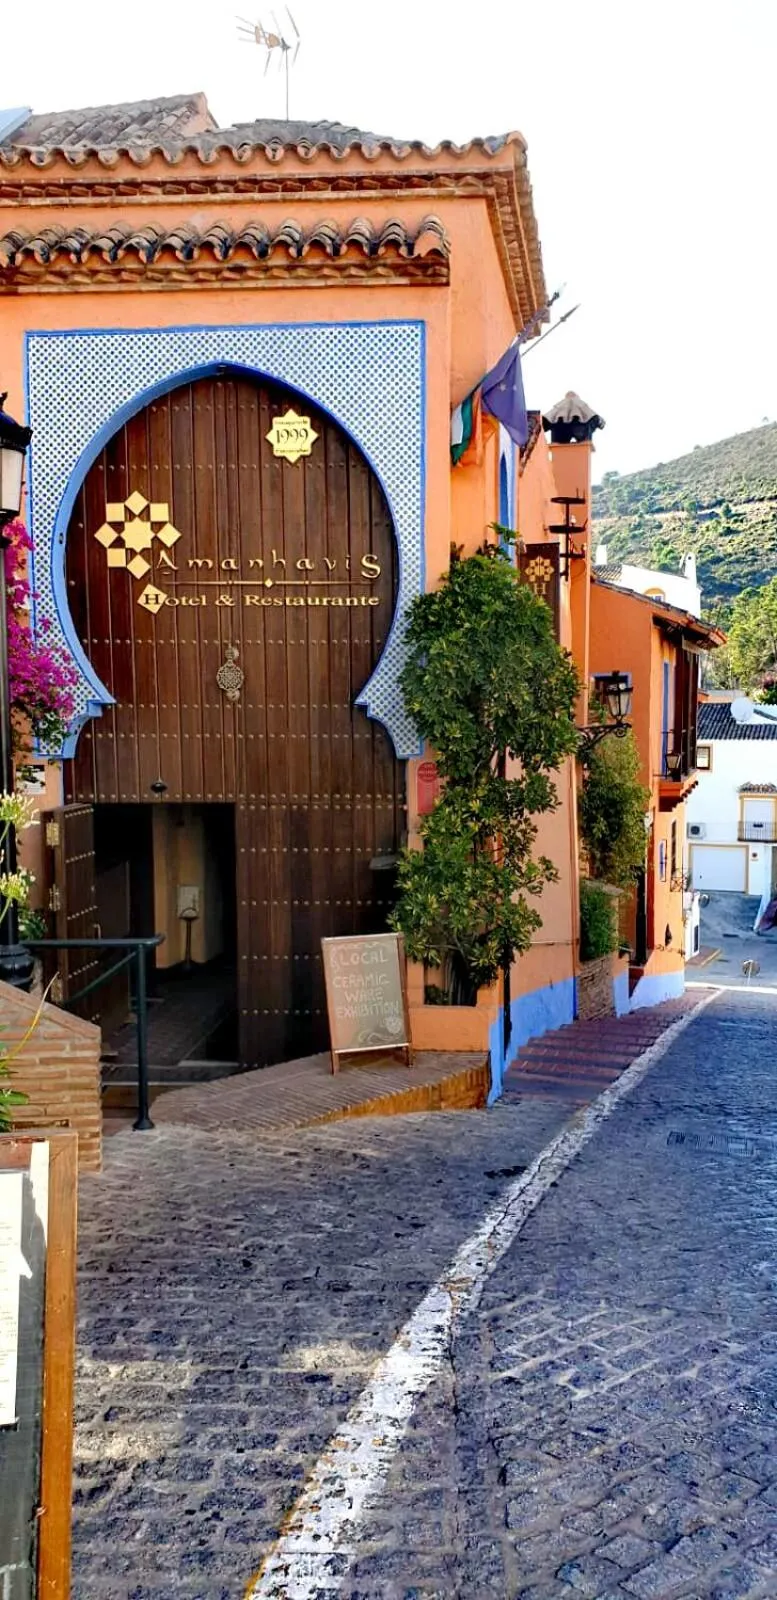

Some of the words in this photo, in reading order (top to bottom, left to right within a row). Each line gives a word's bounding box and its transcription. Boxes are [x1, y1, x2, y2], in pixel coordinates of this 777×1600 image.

[276, 428, 309, 444] 1999
[143, 593, 207, 606] Hotel
[215, 594, 235, 606] &
[245, 594, 380, 606] Restaurante
[340, 949, 388, 965] LOCAL
[333, 973, 390, 988] CERAMIC
[344, 987, 384, 1002] WARE
